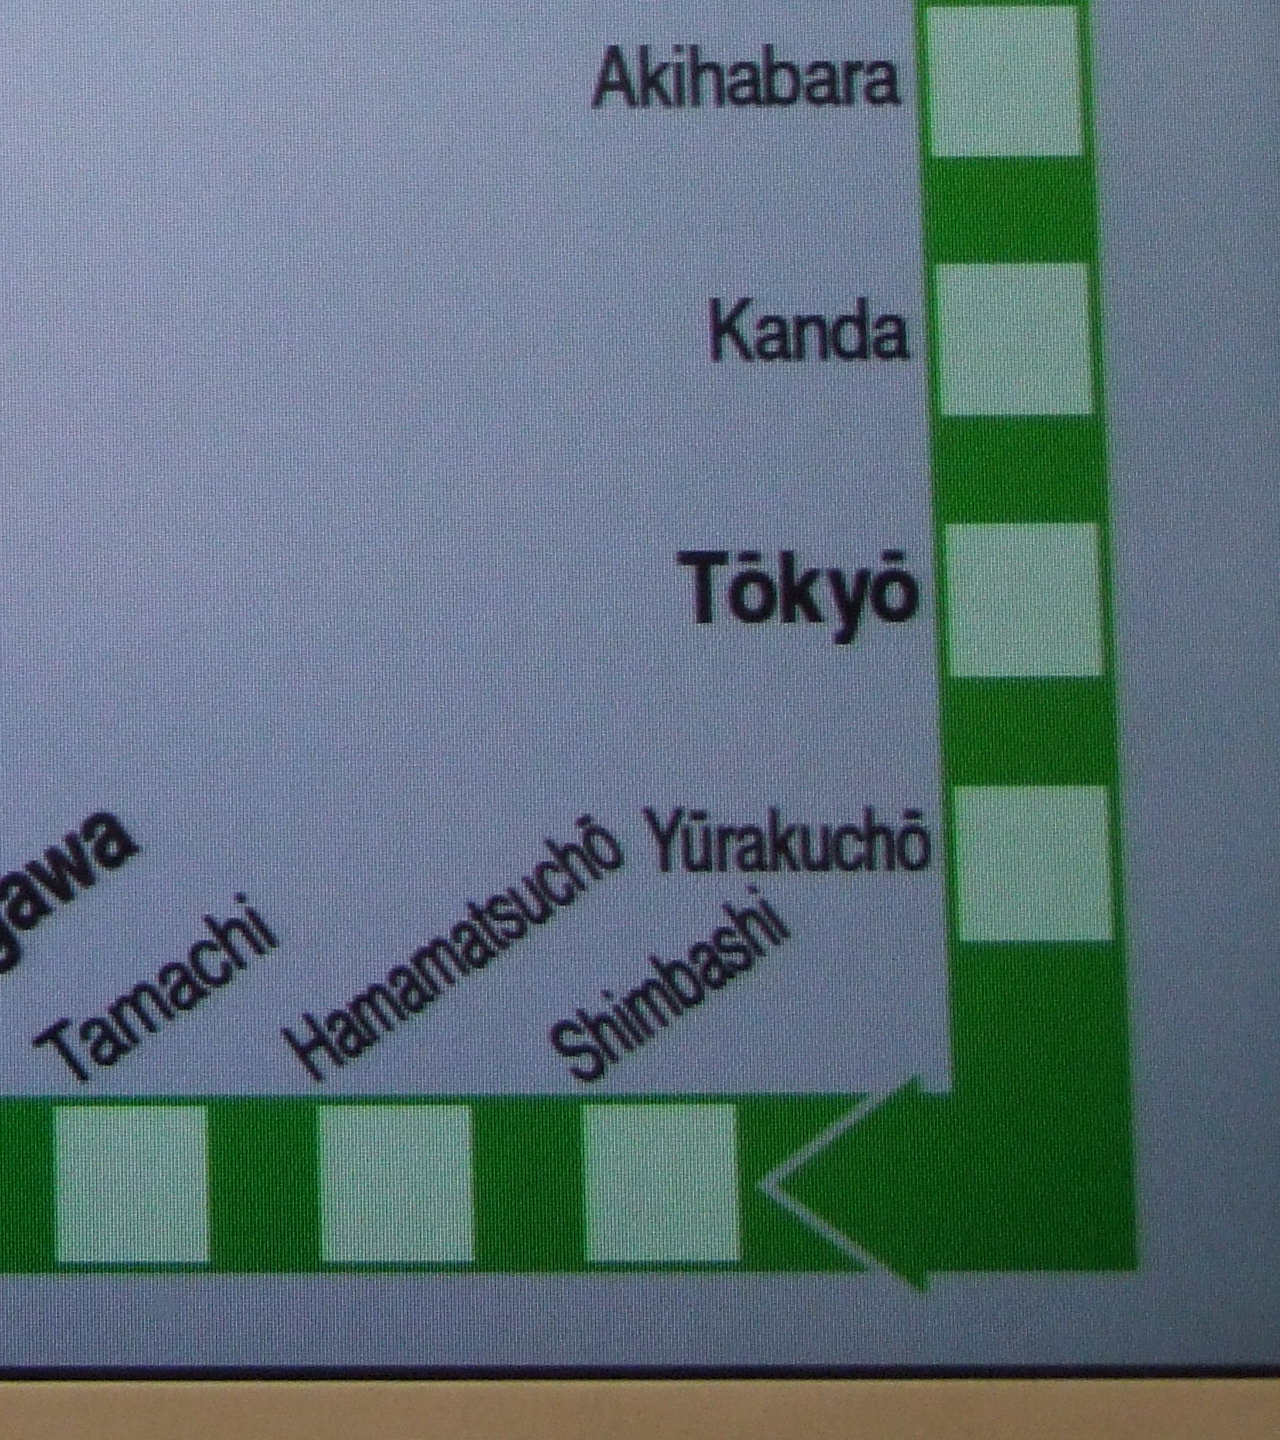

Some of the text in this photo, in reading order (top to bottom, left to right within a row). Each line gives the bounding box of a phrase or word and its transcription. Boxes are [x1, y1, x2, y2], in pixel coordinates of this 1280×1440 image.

[593, 46, 902, 110] Akihabara
[709, 299, 910, 363] Kanda
[678, 550, 920, 644] Tōkyō
[643, 807, 929, 875] Yūrakuchō
[34, 894, 281, 1085] Tamachi
[286, 814, 624, 1083] Hamamatsuchō
[551, 886, 792, 1084] Shimbashi
